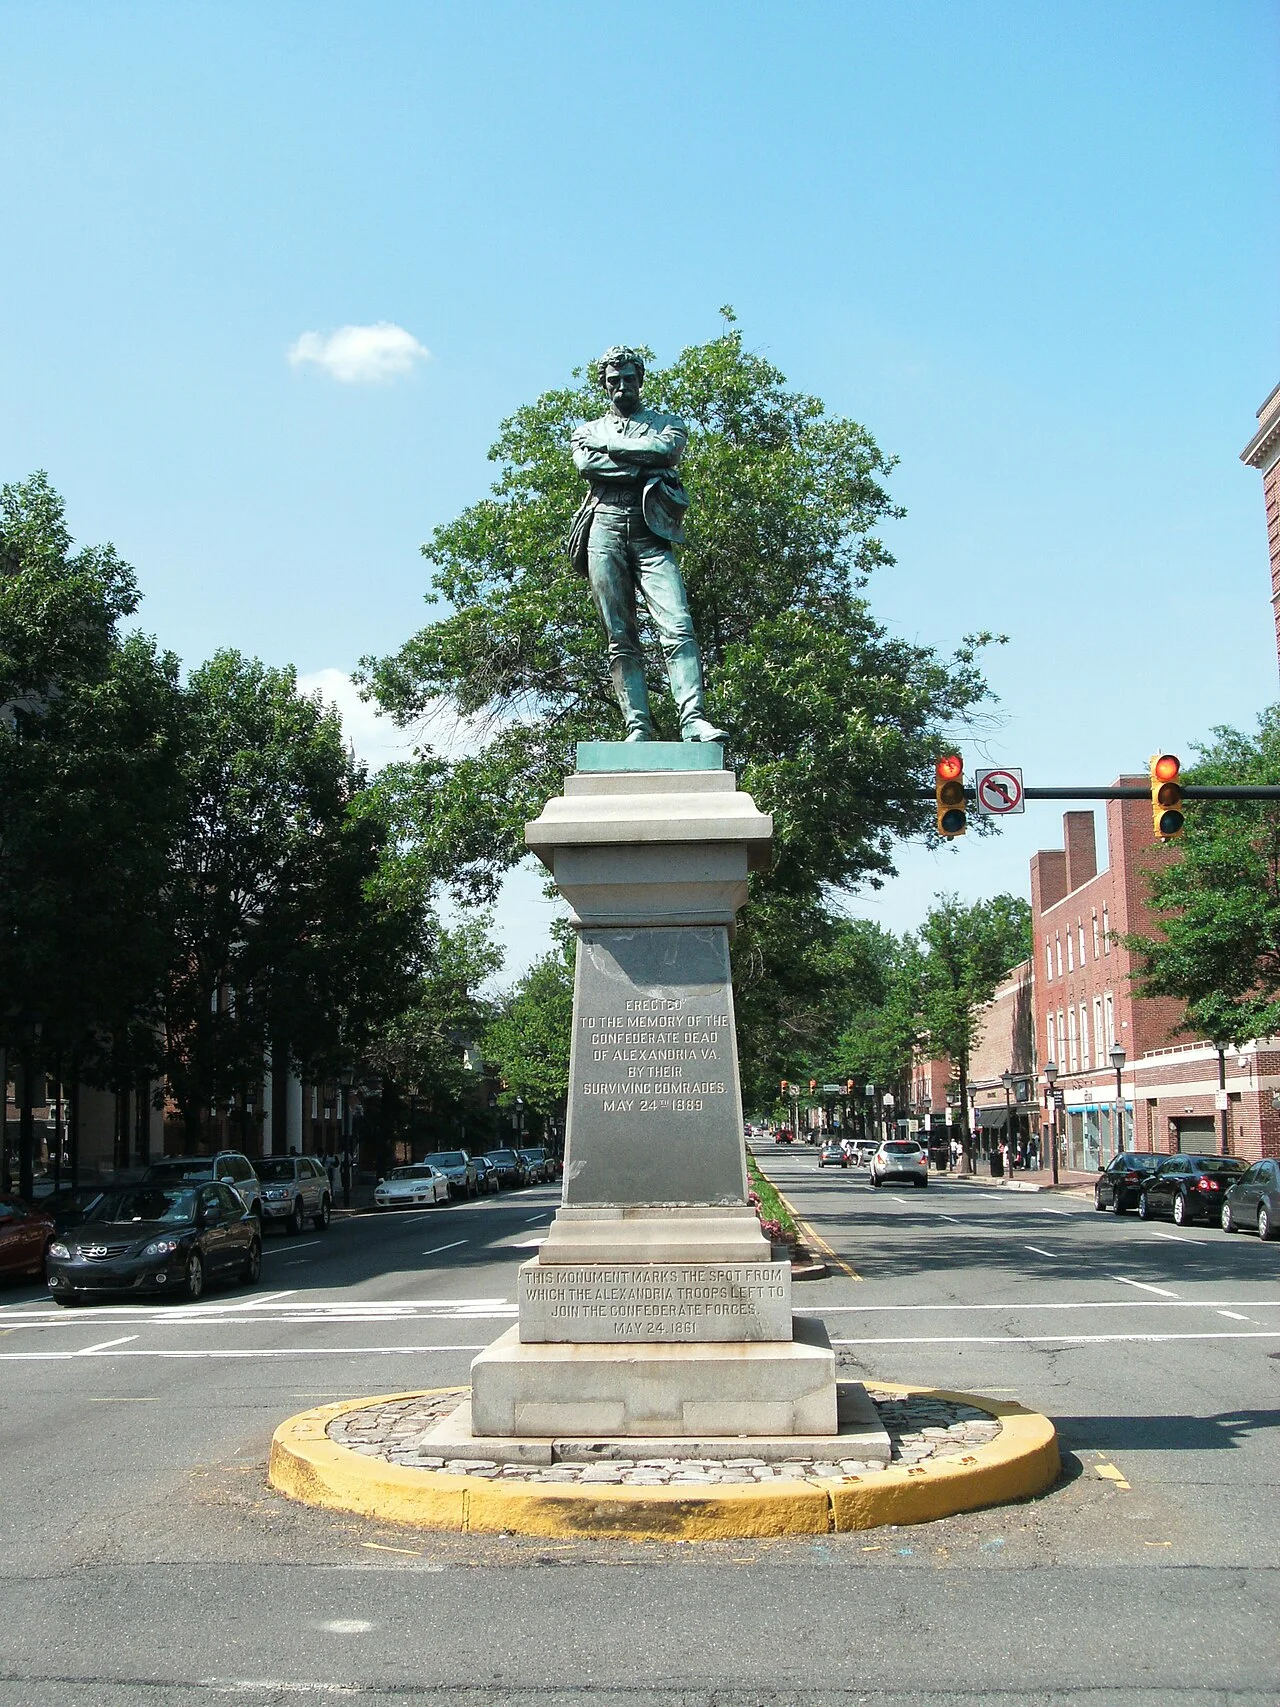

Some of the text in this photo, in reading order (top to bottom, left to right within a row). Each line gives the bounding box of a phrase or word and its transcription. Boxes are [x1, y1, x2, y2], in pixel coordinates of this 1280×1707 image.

[626, 999, 682, 1011] ERECTED
[580, 1015, 728, 1028] TO THE MEMORY OF THE
[591, 1032, 718, 1044] CONFEDERATE DEAD
[593, 1050, 608, 1061] OF
[612, 1049, 697, 1061] ALEXANDRIA
[628, 1066, 682, 1078] BY THEIR
[583, 1083, 651, 1094] SURVIVING
[603, 1100, 633, 1112] MAY
[672, 1100, 703, 1111] 1889
[525, 1269, 782, 1284] THIS MONUMENT MARKS THE SPOT FROM
[526, 1285, 785, 1301] WHICH THE ALEXANDRIA TROOPS LEFT TO
[551, 1305, 580, 1318] JOIN
[583, 1304, 607, 1317] THE
[610, 1303, 703, 1317] CONFEDERATE
[614, 1322, 642, 1334] MAY
